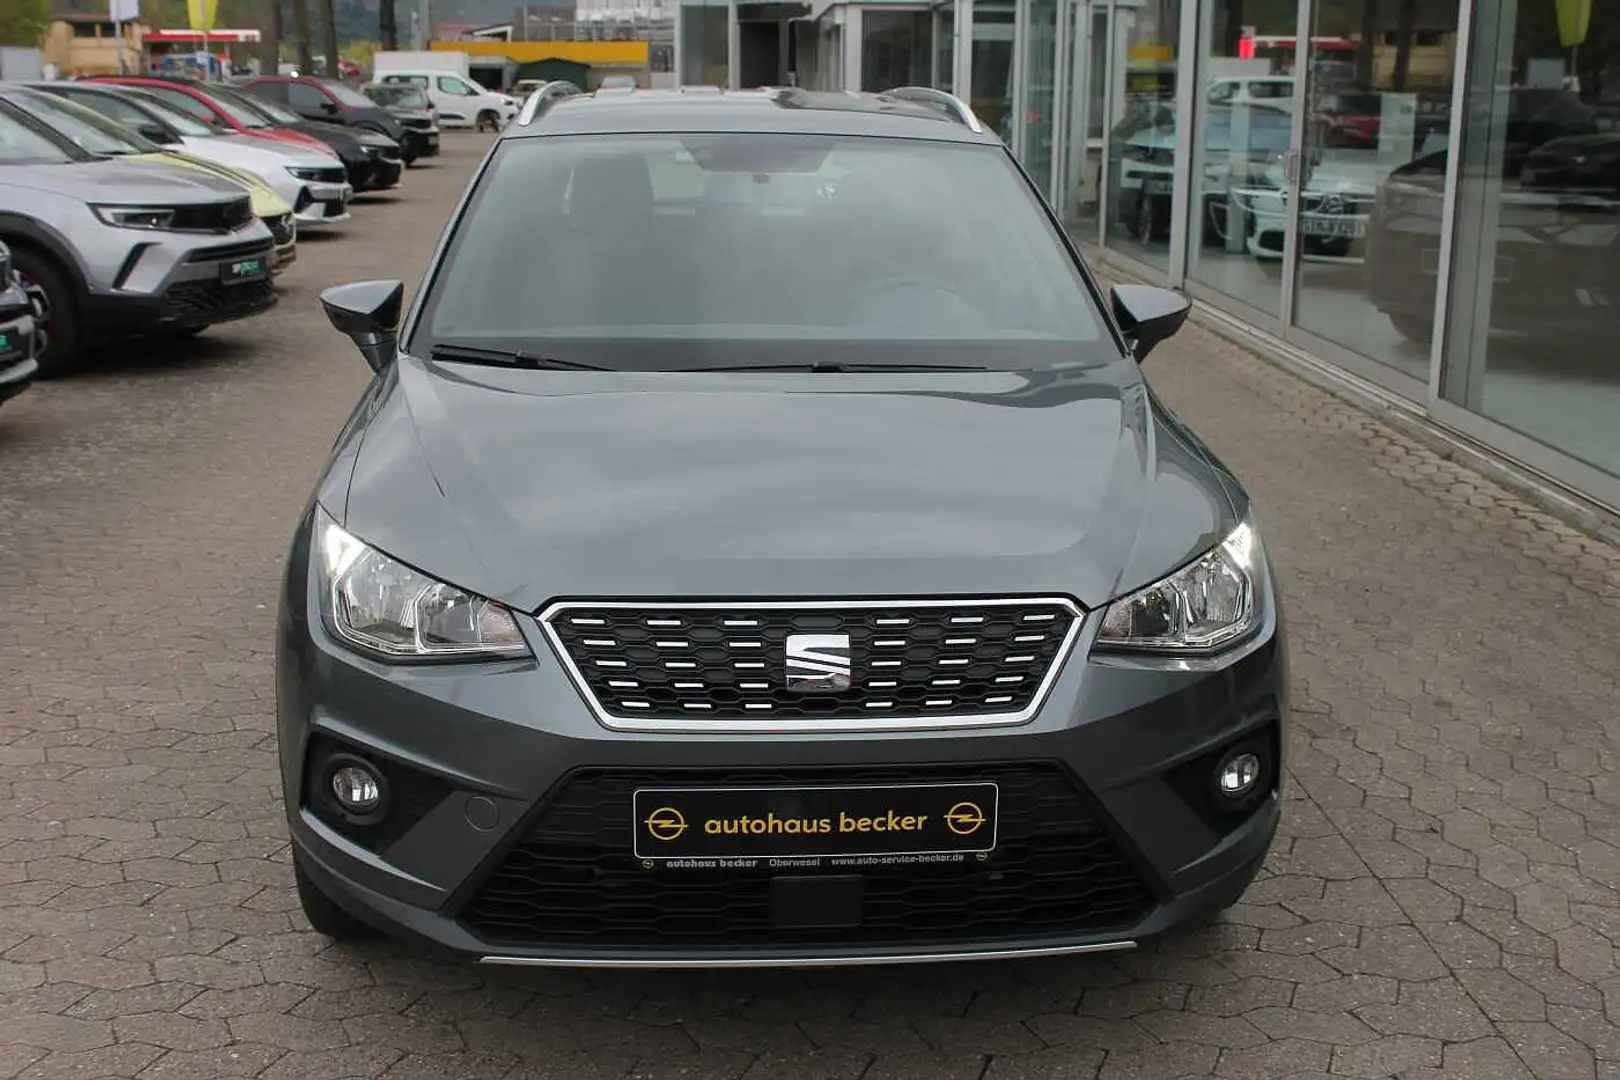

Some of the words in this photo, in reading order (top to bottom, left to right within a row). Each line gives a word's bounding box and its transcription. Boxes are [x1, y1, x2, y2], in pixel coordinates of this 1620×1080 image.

[704, 812, 832, 835] autohaus
[839, 810, 928, 833] becker
[666, 858, 716, 868] autohaus
[719, 858, 758, 868] becker
[831, 854, 964, 867] www.auto-service-becker.de
